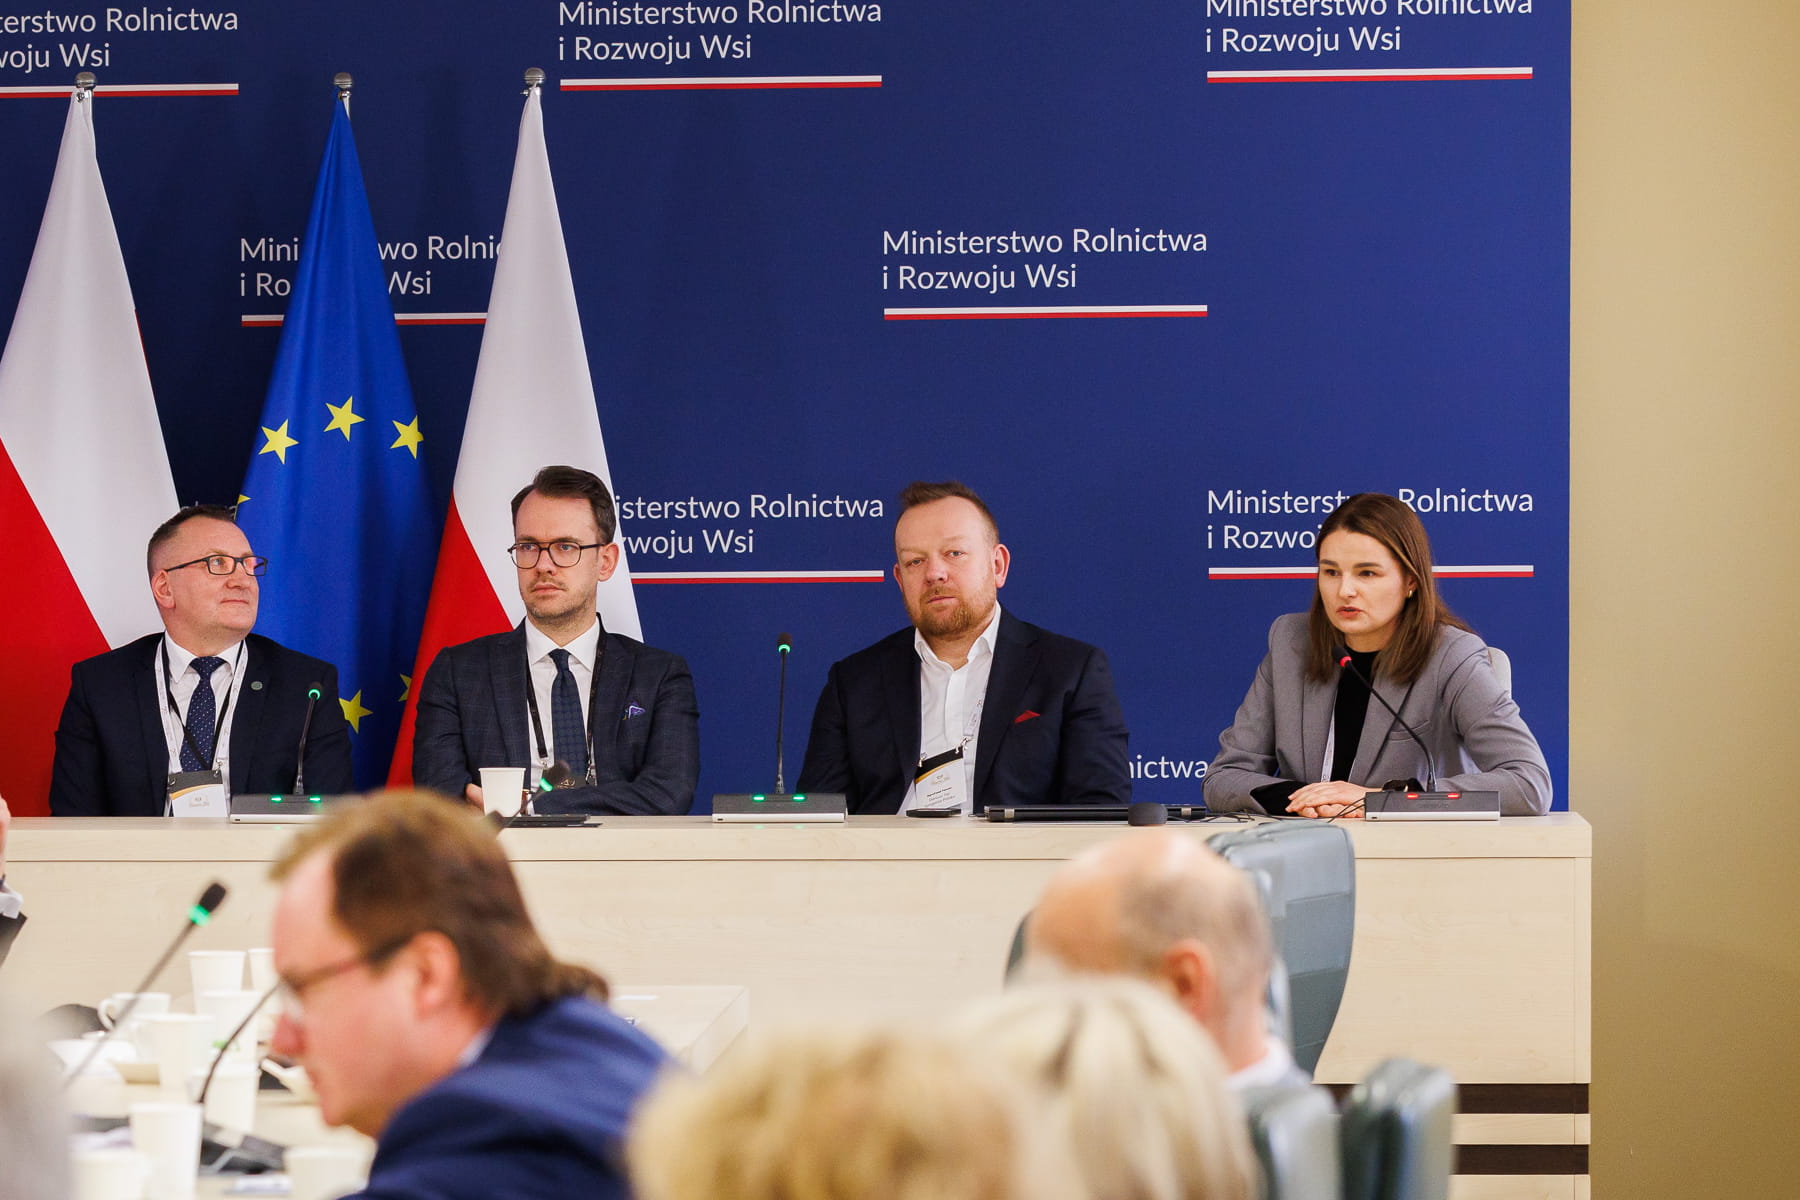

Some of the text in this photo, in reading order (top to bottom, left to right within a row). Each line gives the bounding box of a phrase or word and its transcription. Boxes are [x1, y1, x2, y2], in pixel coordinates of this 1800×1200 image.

[106, 7, 238, 32] Rolnictwa
[559, 0, 882, 26] Ministerstwo Rolnictwa
[1206, 0, 1532, 17] Ministerstwo Rolnictwa
[558, 33, 752, 65] i Rozwoju Wsi
[1205, 25, 1401, 57] i Rozwoju Wsi
[58, 42, 110, 68] Wsi
[428, 234, 501, 260] Rolni
[883, 227, 1207, 255] Ministerstwo Rolnictwa
[240, 272, 246, 297] i
[882, 263, 1077, 294] i Rozwoju Wsi
[615, 493, 884, 520] isterstwo Rolnictwa
[1207, 487, 1533, 514] Ministerst Rolnictwa
[621, 528, 754, 560] woju Wsi
[1207, 524, 1322, 550] i Rozwo
